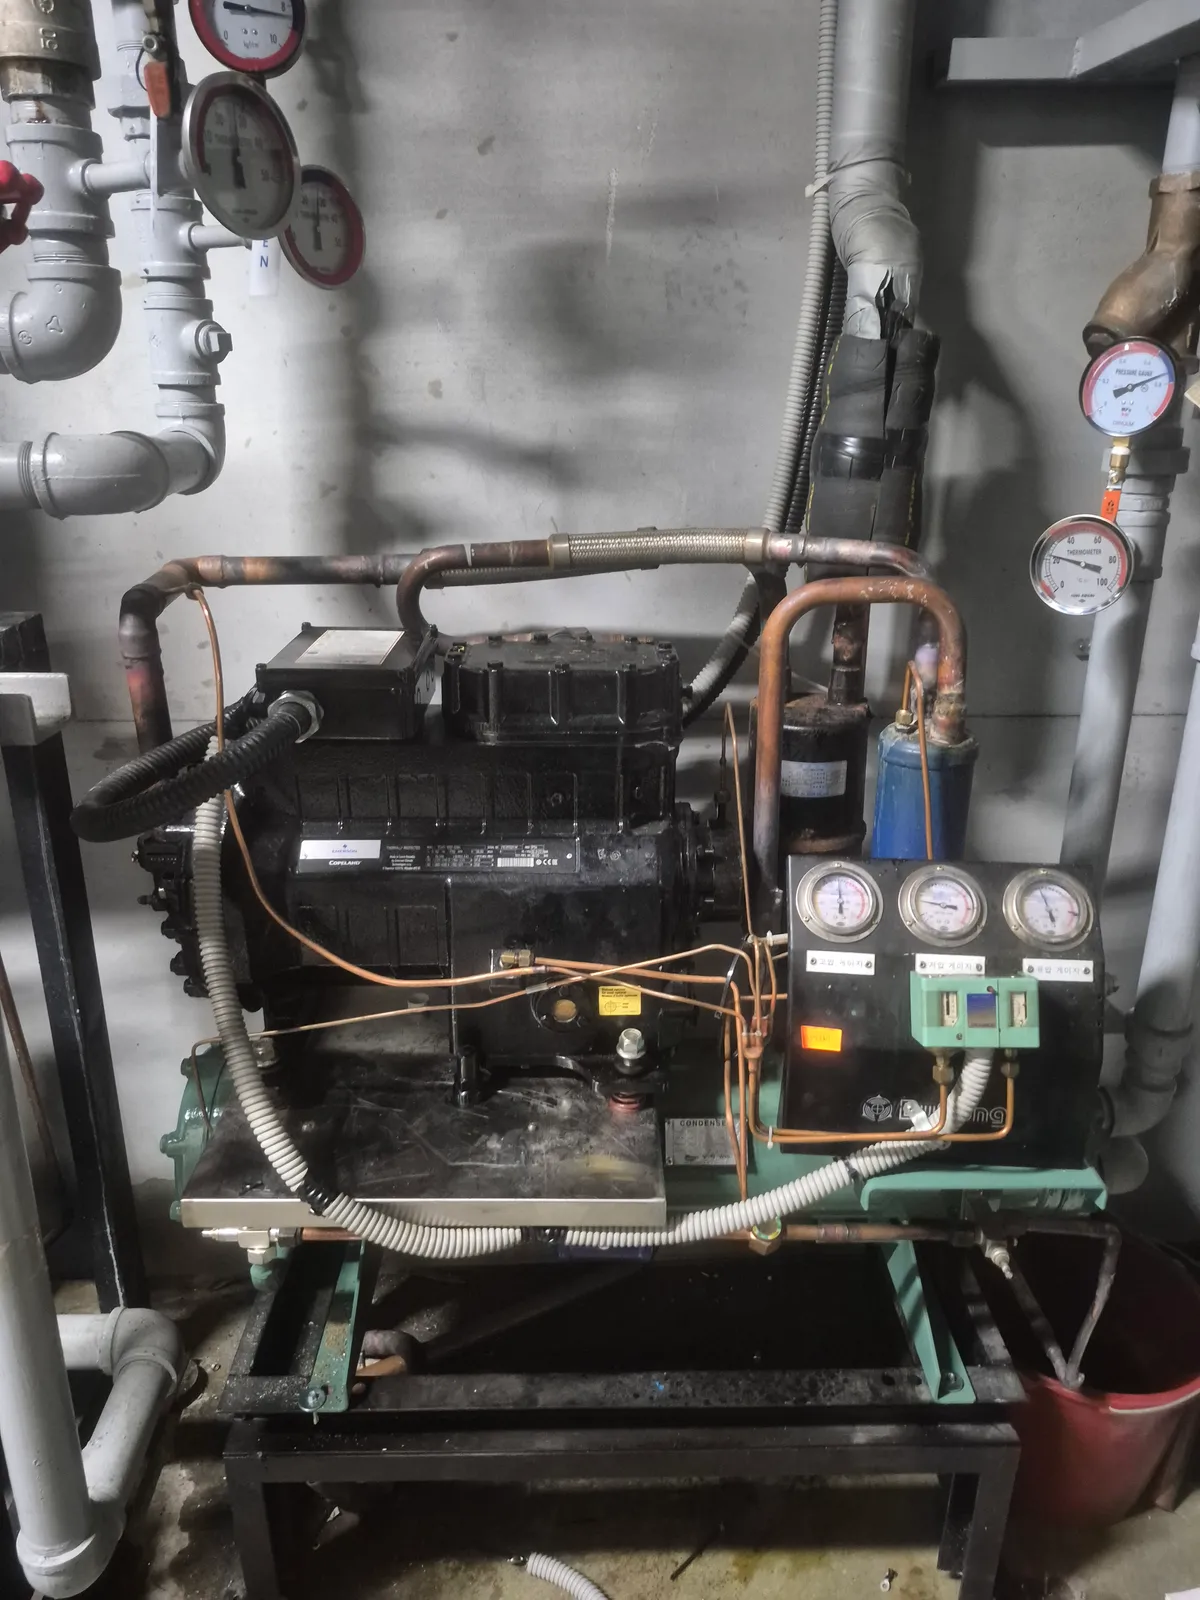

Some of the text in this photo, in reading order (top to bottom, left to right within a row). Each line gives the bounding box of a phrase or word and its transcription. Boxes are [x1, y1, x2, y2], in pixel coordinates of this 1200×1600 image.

[224, 30, 229, 40] 0
[270, 33, 278, 44] 10
[1115, 368, 1153, 377] PRESSURE GAUGE
[1067, 536, 1075, 545] 40
[1094, 536, 1102, 544] 60
[1067, 548, 1102, 556] THERMOMETER
[1052, 556, 1061, 565] 20
[1108, 556, 1117, 564] 80
[1060, 580, 1065, 589] 0
[1096, 578, 1108, 587] 100
[680, 1119, 728, 1127] CONDENSE
